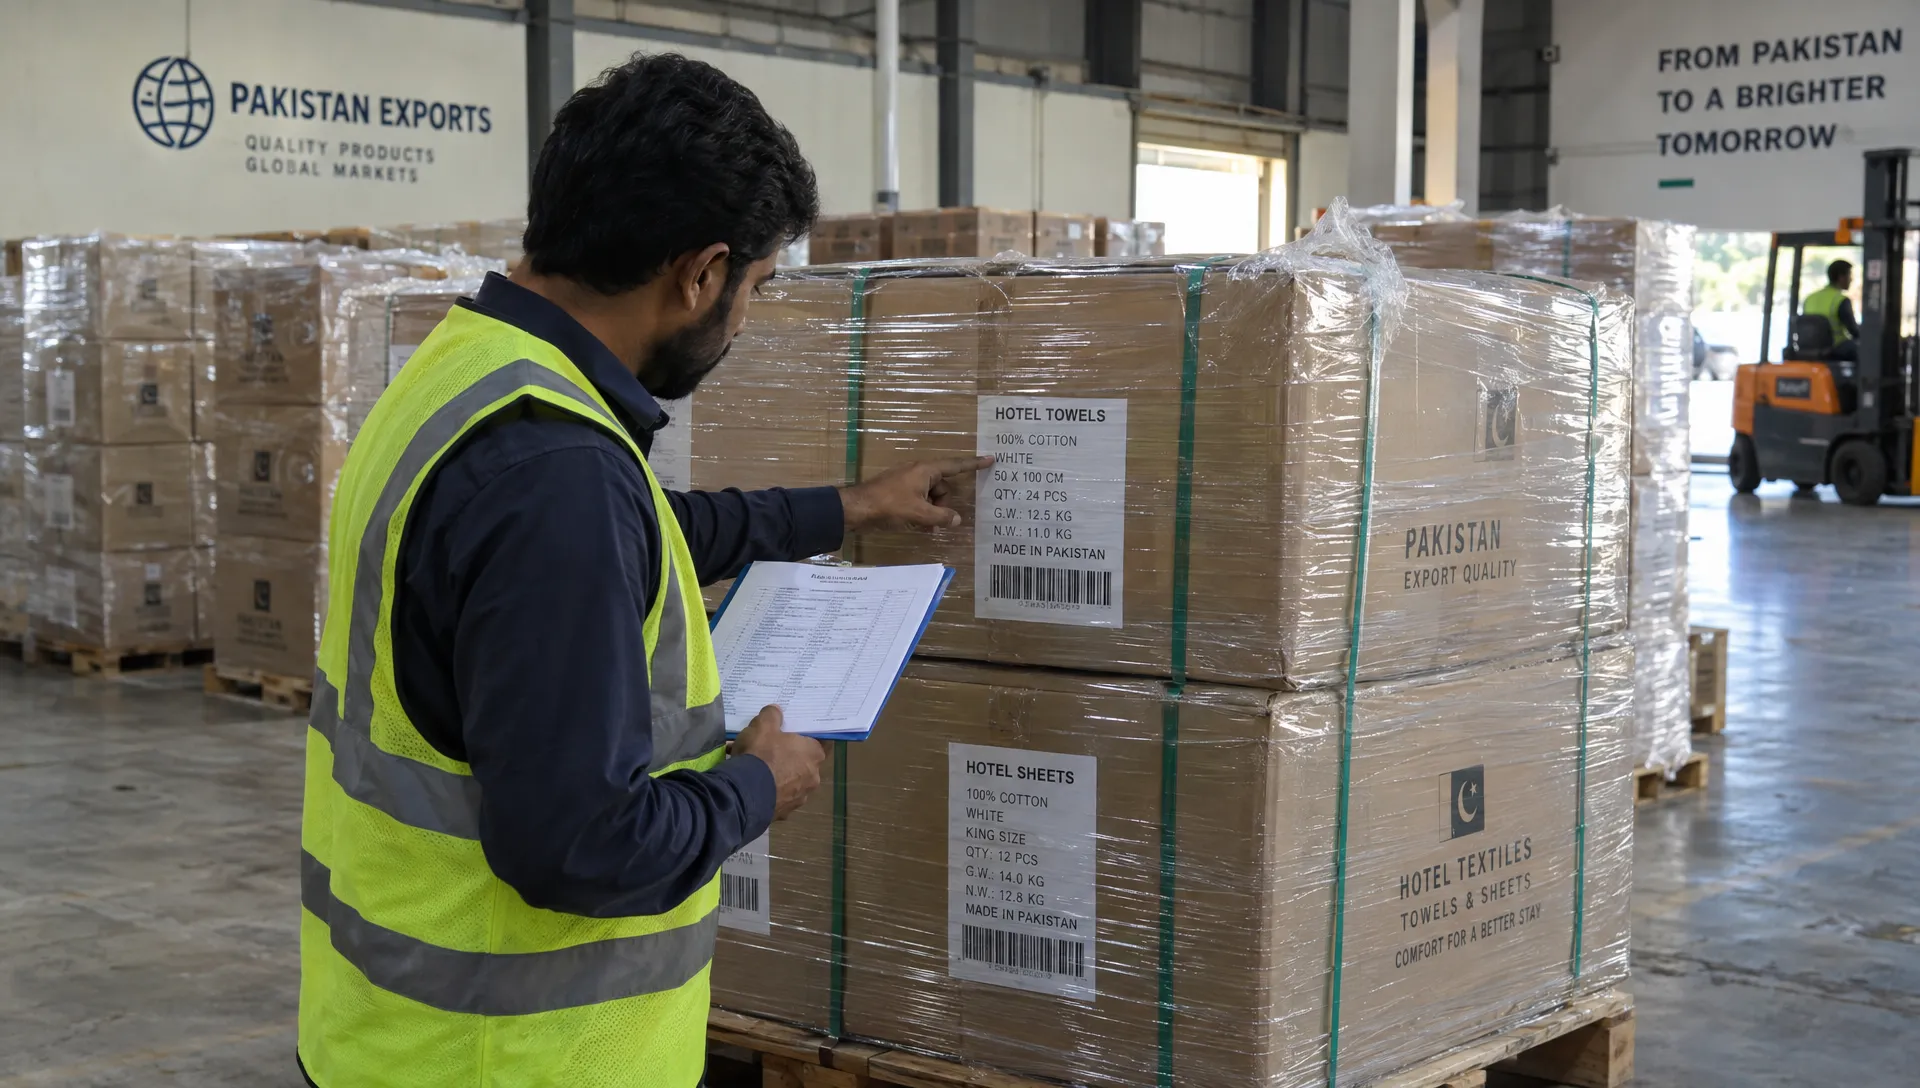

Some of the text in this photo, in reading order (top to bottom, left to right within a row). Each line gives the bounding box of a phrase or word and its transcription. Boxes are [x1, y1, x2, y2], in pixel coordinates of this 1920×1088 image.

[1659, 27, 1902, 73] FROM PAKISTAN
[1657, 74, 1885, 115] TO A BRIGHTER
[231, 81, 492, 133] PAKISTAN EXPORTS
[245, 134, 435, 164] QUALITY PRODUCTS
[1656, 123, 1837, 157] TOMORROW
[245, 156, 418, 183] GLOBAL MARKETS
[995, 407, 1106, 422] HOTEL TOWELS
[996, 434, 1077, 446] 100% COTTON
[994, 452, 1033, 464] WHITE
[994, 471, 1064, 483] 50 X 100 CM
[994, 489, 1068, 502] QTY: 24 PCS
[994, 508, 1072, 522] G.W.: 12.5 KG
[993, 525, 1072, 540] N.W.: 11.0 KG
[1405, 519, 1501, 559] PAKISTAN
[993, 543, 1105, 560] MADE IN PAKISTAN
[1404, 559, 1517, 590] EXPORT QUALITY
[966, 760, 1075, 784] HOTEL SHEETS
[966, 788, 1048, 808] 100% COTTON
[966, 807, 1004, 823] WHITE
[966, 827, 1026, 845] KING SIZE
[966, 845, 1038, 866] QTY: 12 PCS
[965, 865, 1044, 887] G.W.: 14.0 KG
[1400, 837, 1532, 900] HOTEL TEXTILES
[965, 884, 1044, 906] N.W.: 12.8 KG
[1401, 872, 1531, 932] TOWELS & SHEETS
[965, 903, 1077, 930] MADE IN PAKISTAN
[1395, 903, 1541, 969] COMFORT FOR A BETTER STAY
